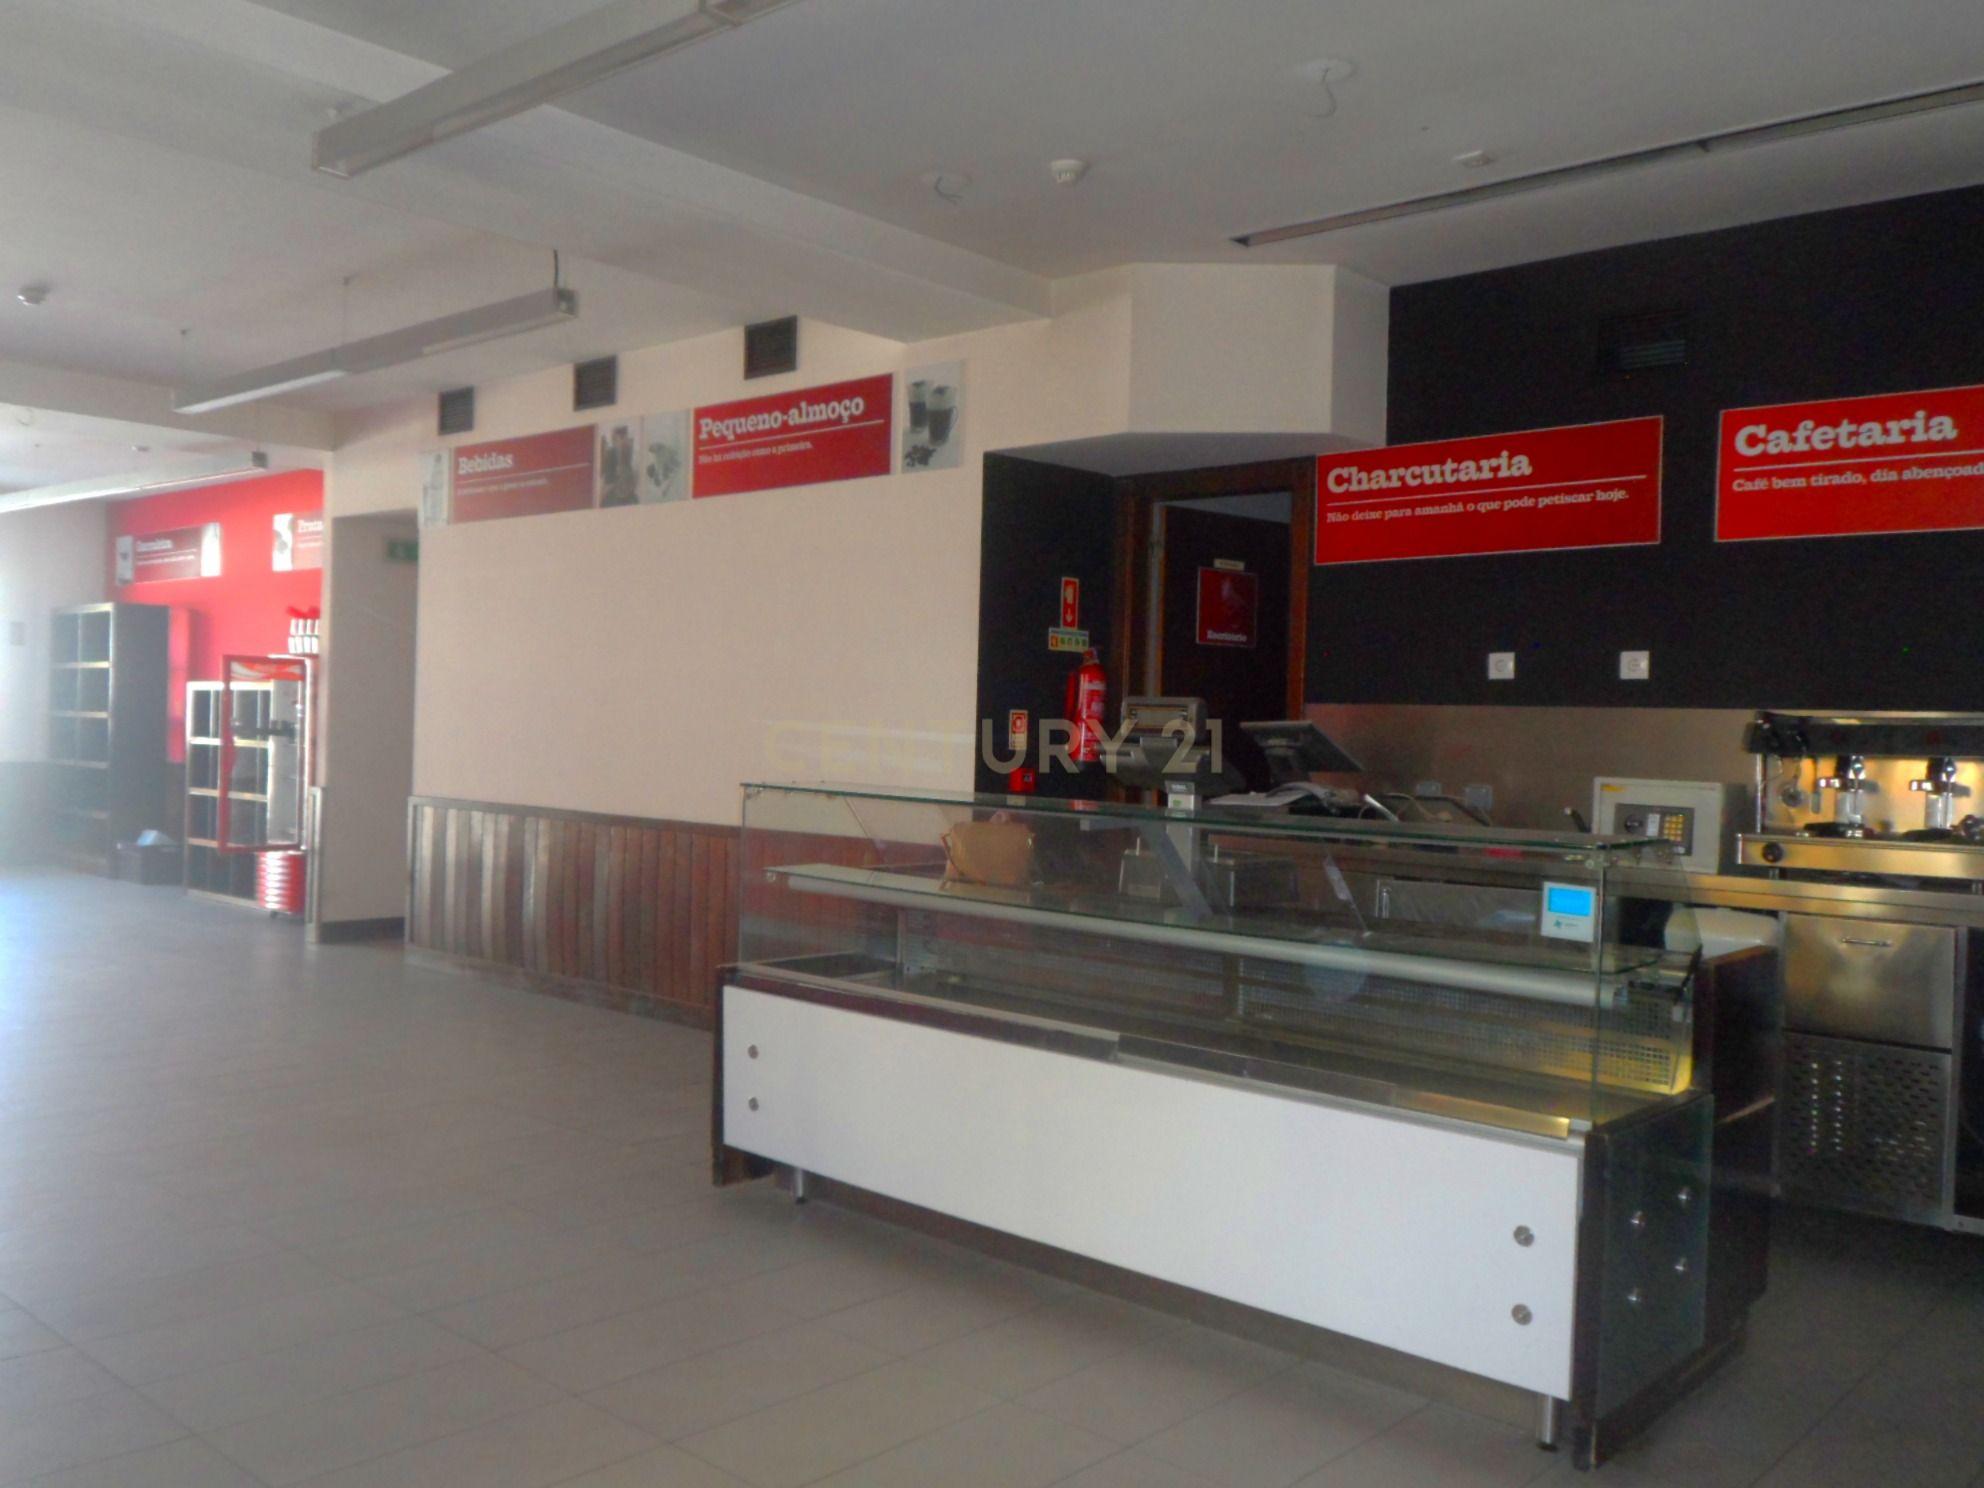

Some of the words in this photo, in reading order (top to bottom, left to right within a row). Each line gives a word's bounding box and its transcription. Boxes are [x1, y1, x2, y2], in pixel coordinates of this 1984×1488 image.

[699, 396, 865, 441] Pequeno-almoço
[1734, 410, 1959, 457] Cafetaria
[1326, 450, 1533, 494] Charcutaria
[1732, 477, 1769, 492] Café
[1771, 476, 1807, 490] bem
[1810, 470, 1868, 487] tirado,
[1869, 468, 1899, 482] dia
[1326, 511, 1349, 523] Não
[1352, 509, 1383, 521] deixe
[1384, 508, 1412, 523] para
[1414, 502, 1464, 516] amanhã
[1466, 501, 1476, 512] o
[1477, 499, 1501, 514] que
[1503, 496, 1536, 511] pode
[1537, 492, 1595, 509] petiscar
[1595, 488, 1630, 502] hoje.
